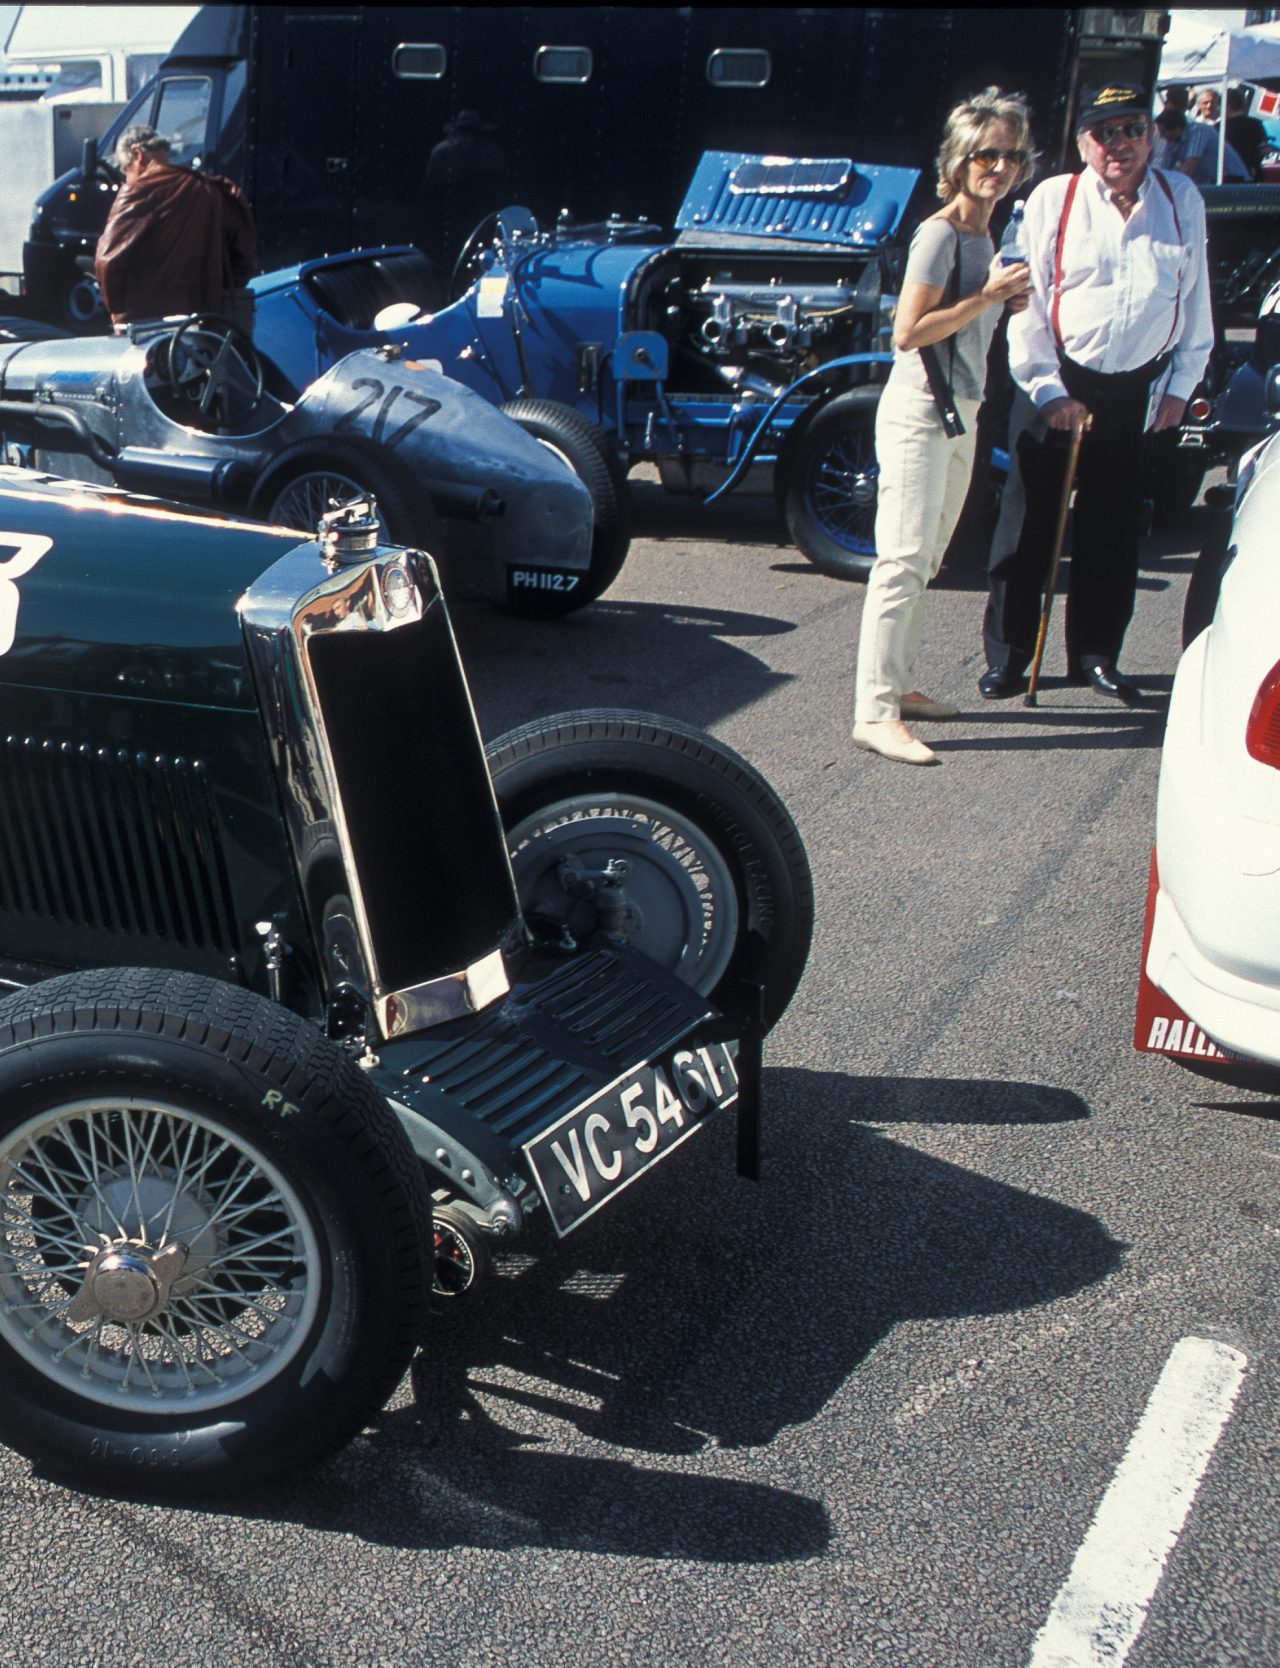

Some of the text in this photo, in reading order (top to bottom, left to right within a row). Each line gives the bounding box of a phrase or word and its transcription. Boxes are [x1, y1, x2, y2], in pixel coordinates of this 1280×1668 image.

[333, 377, 442, 449] 217
[261, 1089, 300, 1117] RF
[549, 1047, 724, 1202] VC 5461
